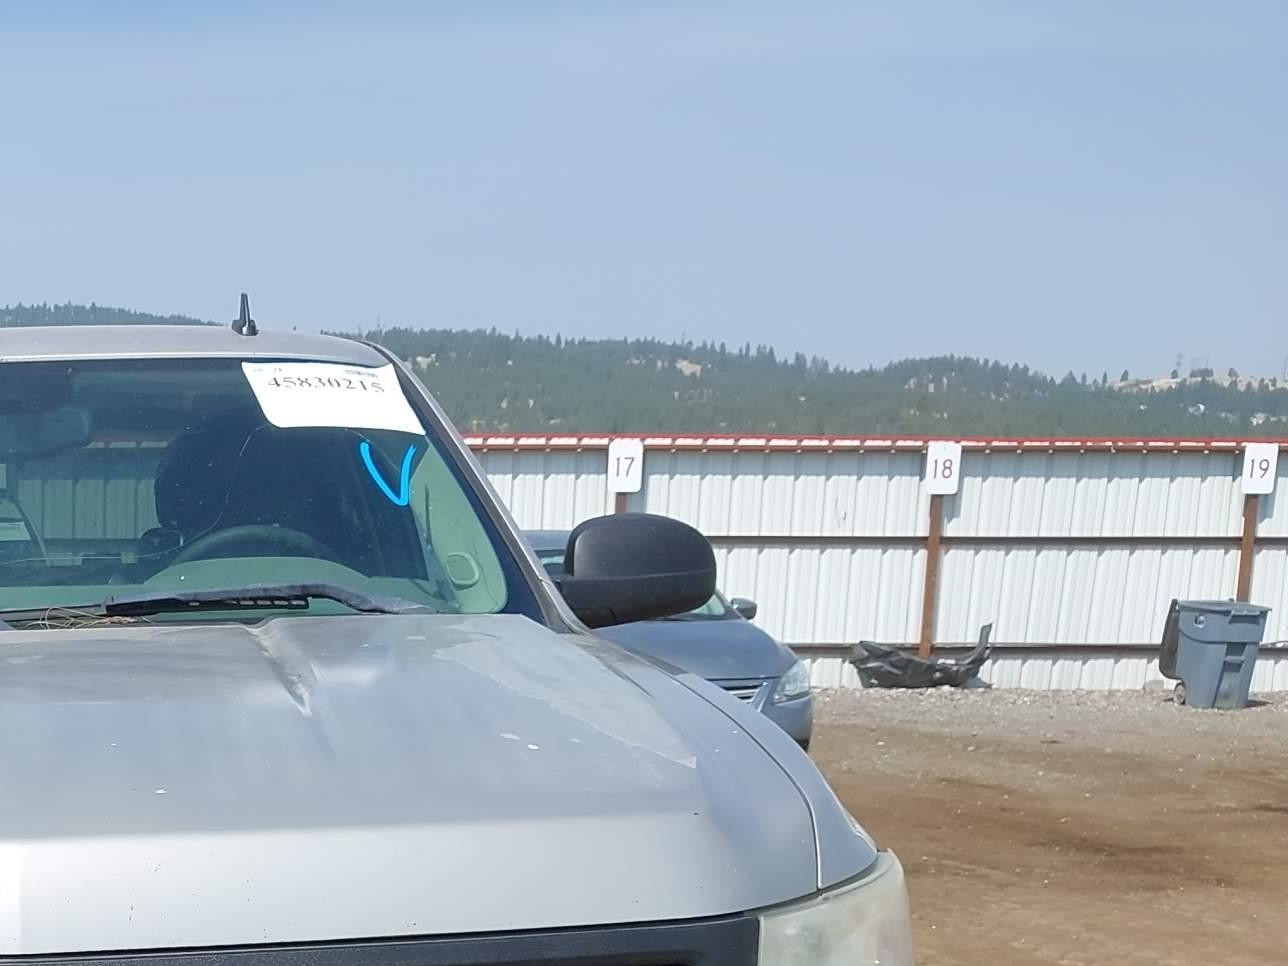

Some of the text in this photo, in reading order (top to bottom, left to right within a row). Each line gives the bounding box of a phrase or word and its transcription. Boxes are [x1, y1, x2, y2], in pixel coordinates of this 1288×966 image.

[267, 376, 385, 393] 45830215
[616, 456, 635, 478] 17
[933, 458, 953, 479] 18
[1249, 458, 1270, 479] 19
